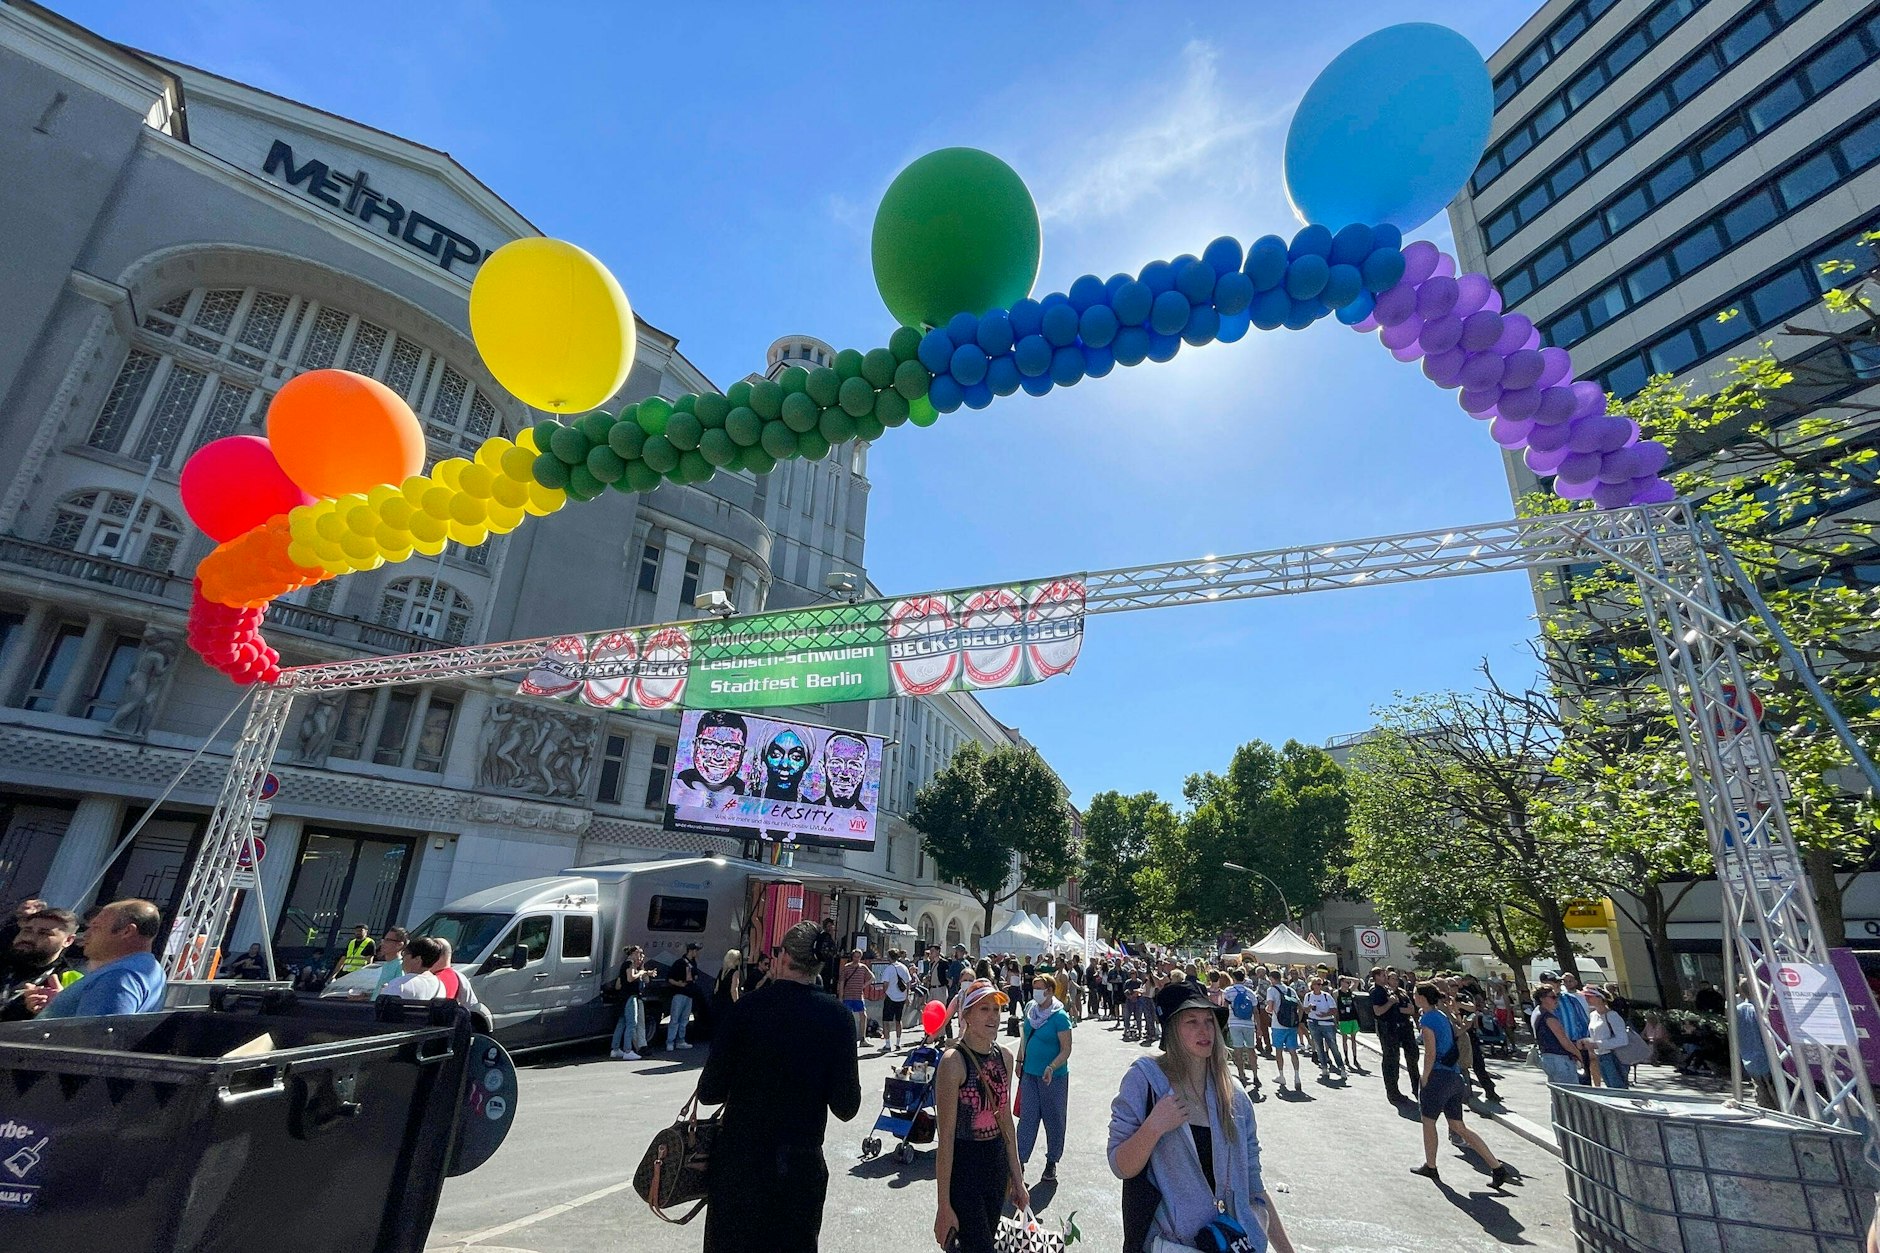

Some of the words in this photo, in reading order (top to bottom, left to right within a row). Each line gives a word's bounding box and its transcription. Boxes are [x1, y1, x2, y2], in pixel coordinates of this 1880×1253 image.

[263, 139, 493, 270] METROP
[700, 646, 874, 671] Lesbisch-Schwulen
[711, 675, 799, 693] Stadtfest
[806, 672, 862, 689] Berlin
[1364, 935, 1377, 944] 30
